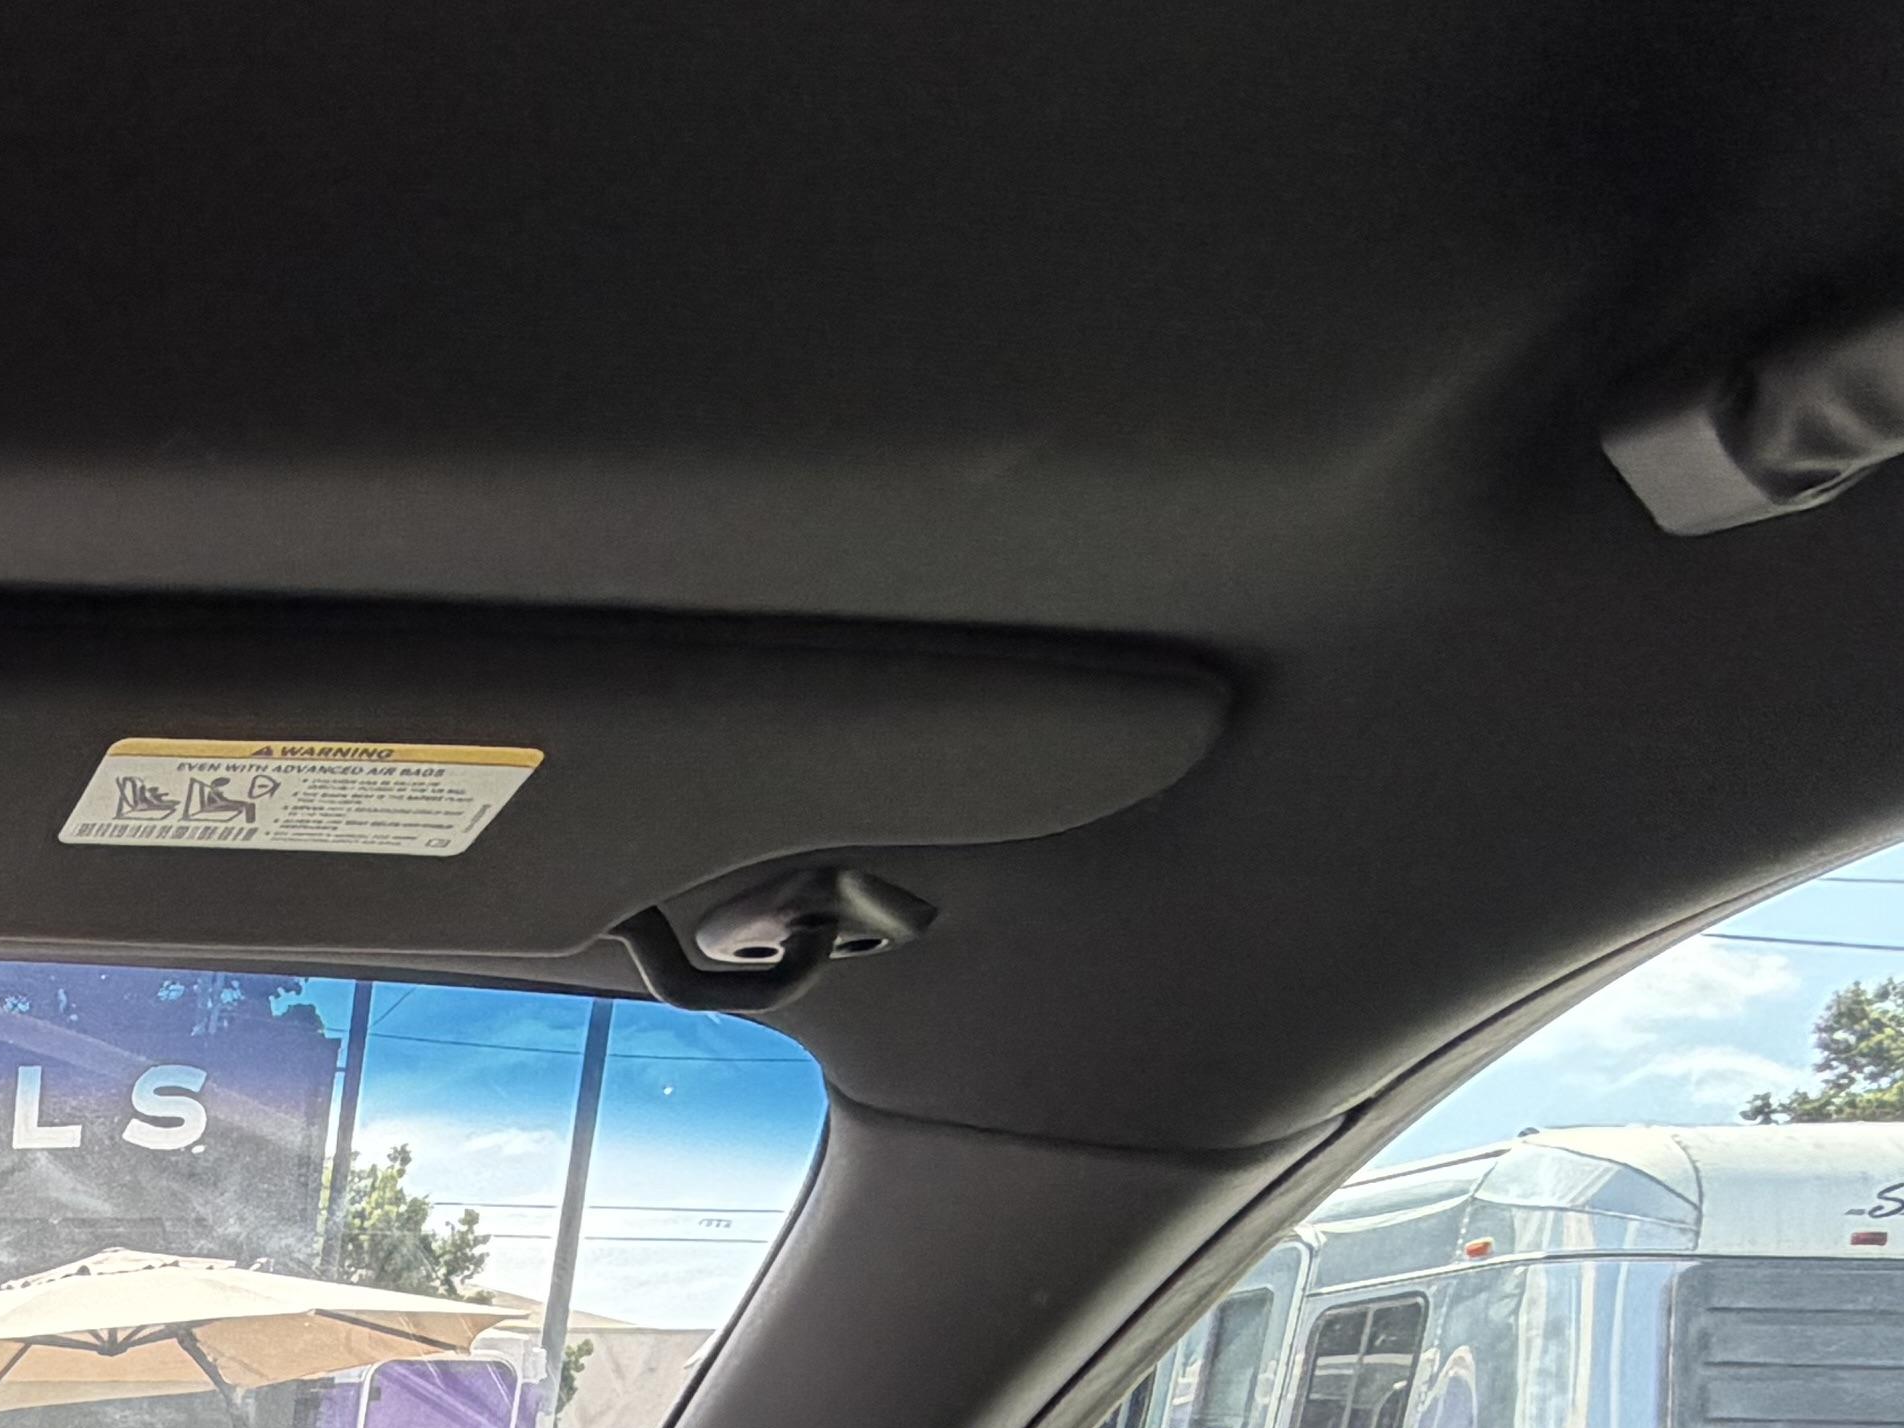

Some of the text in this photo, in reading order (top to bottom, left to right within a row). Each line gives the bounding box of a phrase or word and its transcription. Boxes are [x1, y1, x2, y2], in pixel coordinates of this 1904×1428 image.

[281, 746, 395, 759] WARNING
[176, 762, 447, 777] EVEN WITH ADVANCED AIR BAGS
